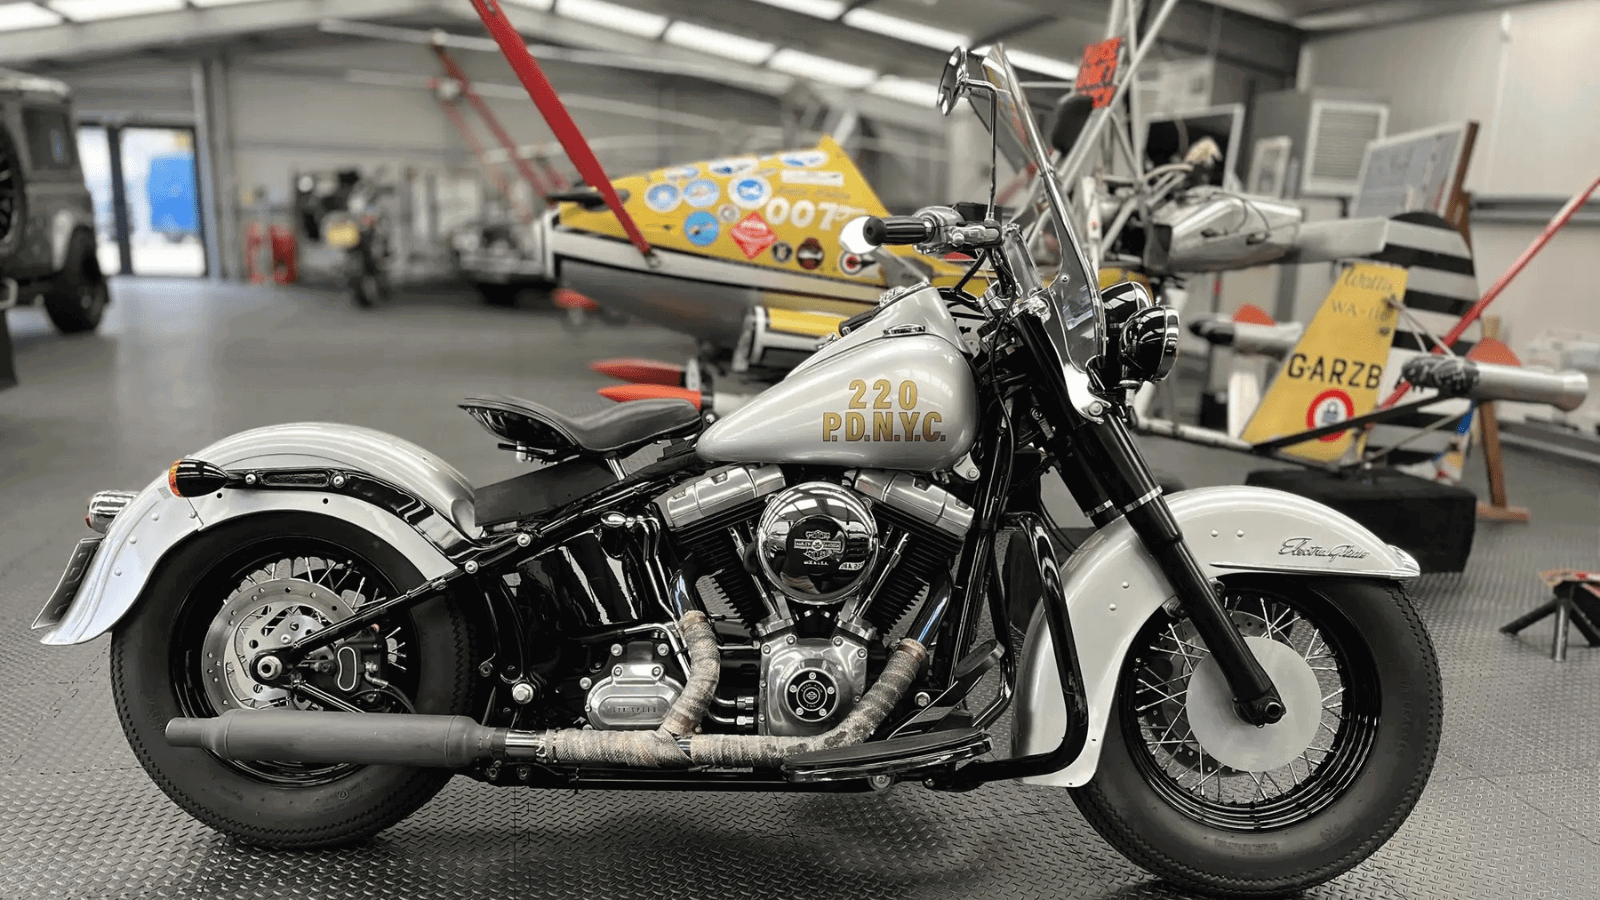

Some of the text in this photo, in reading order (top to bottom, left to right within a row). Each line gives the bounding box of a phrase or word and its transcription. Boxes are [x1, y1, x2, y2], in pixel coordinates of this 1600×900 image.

[765, 197, 838, 231] 007
[848, 379, 918, 411] 220
[822, 411, 947, 442] P.D.N.Y.C.
